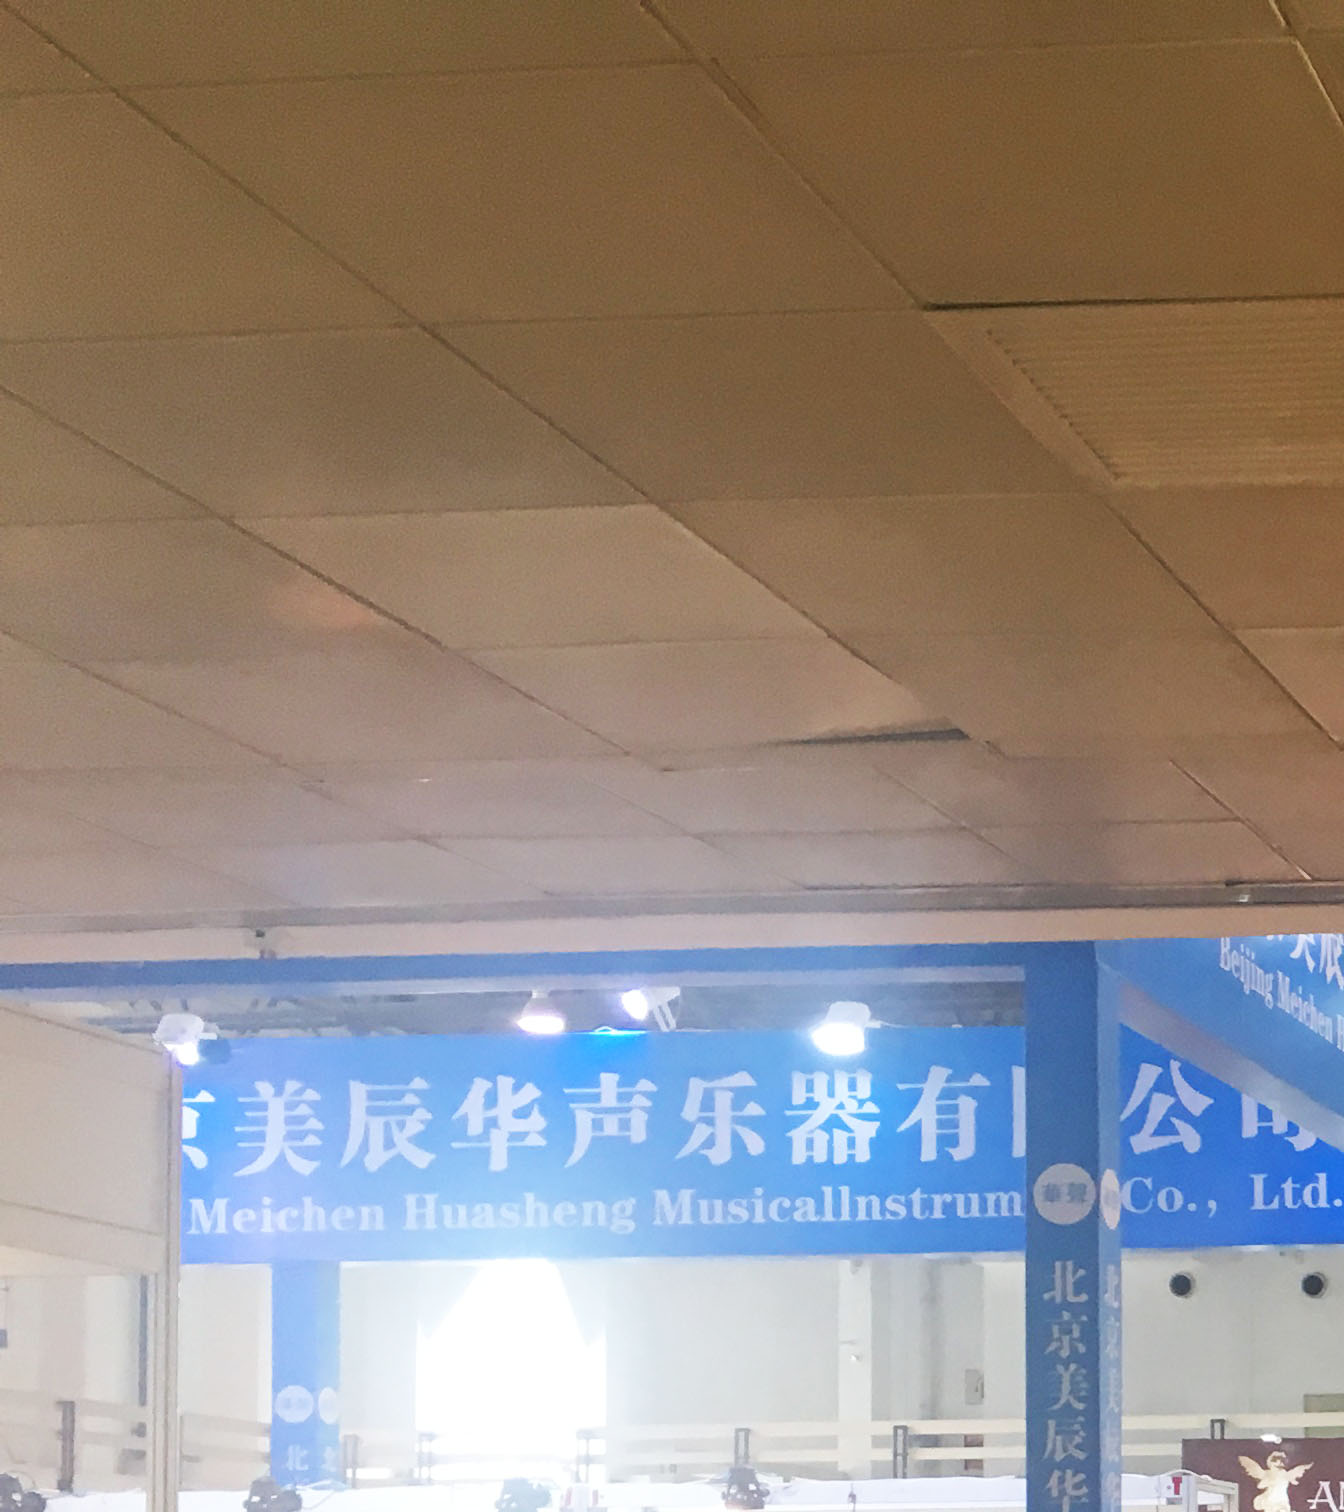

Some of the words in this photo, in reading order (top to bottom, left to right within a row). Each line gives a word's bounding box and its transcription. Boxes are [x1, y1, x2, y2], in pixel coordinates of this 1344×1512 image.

[187, 1195, 385, 1236] Meichen
[402, 1191, 637, 1235] Huasheng
[1121, 1176, 1217, 1218] Co.,
[1250, 1172, 1344, 1213] Ltd.
